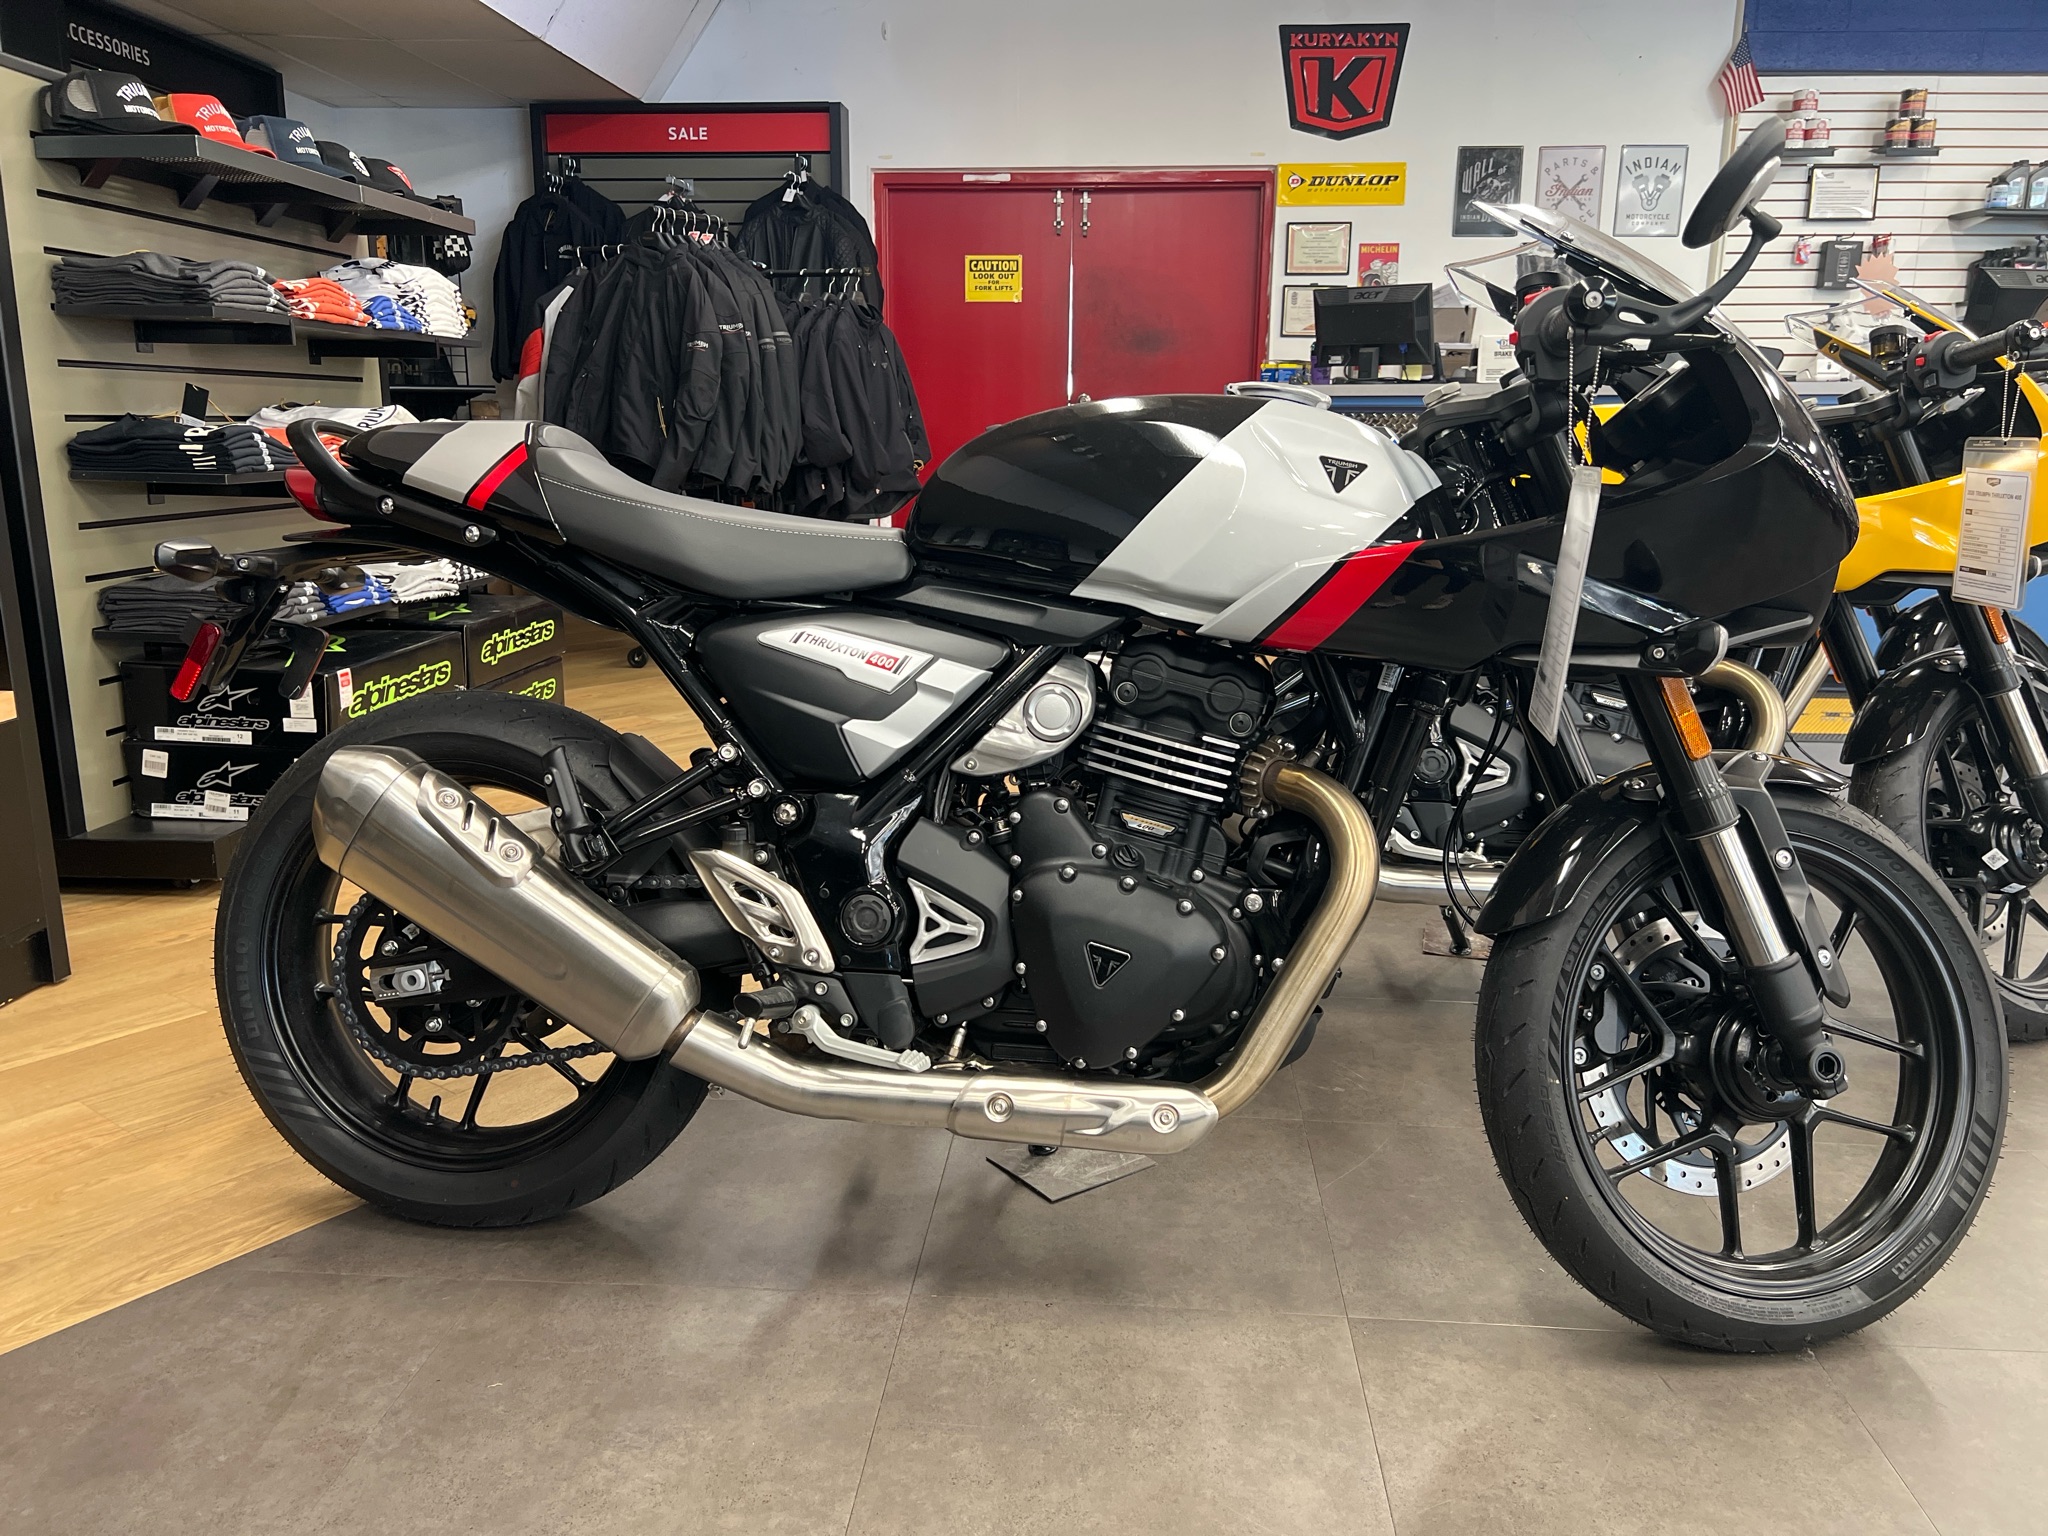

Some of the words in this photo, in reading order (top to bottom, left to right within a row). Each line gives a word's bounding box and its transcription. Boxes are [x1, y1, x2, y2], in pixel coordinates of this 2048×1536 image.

[67, 23, 150, 66] CCESSORIES
[1290, 32, 1399, 47] KURYAKYN
[668, 126, 708, 141] SALE
[1497, 165, 1508, 176] OF
[1544, 157, 1588, 176] PARTS
[1625, 156, 1682, 176] INDIAN
[1307, 175, 1399, 187] DUNLOP
[1462, 157, 1494, 194] WALL
[1545, 181, 1594, 197] Indian
[1360, 246, 1398, 254] MICHELIN
[970, 260, 1018, 271] CAUTION
[1353, 290, 1384, 300] acer
[1327, 458, 1358, 469] TRIUMPH
[480, 619, 555, 666] alpinestars
[802, 633, 871, 661] THRUXTON
[868, 652, 895, 670] 400
[348, 660, 452, 719] alpinestars
[177, 713, 270, 731] alpinestars
[1891, 1231, 1942, 1281] PIRELLI
